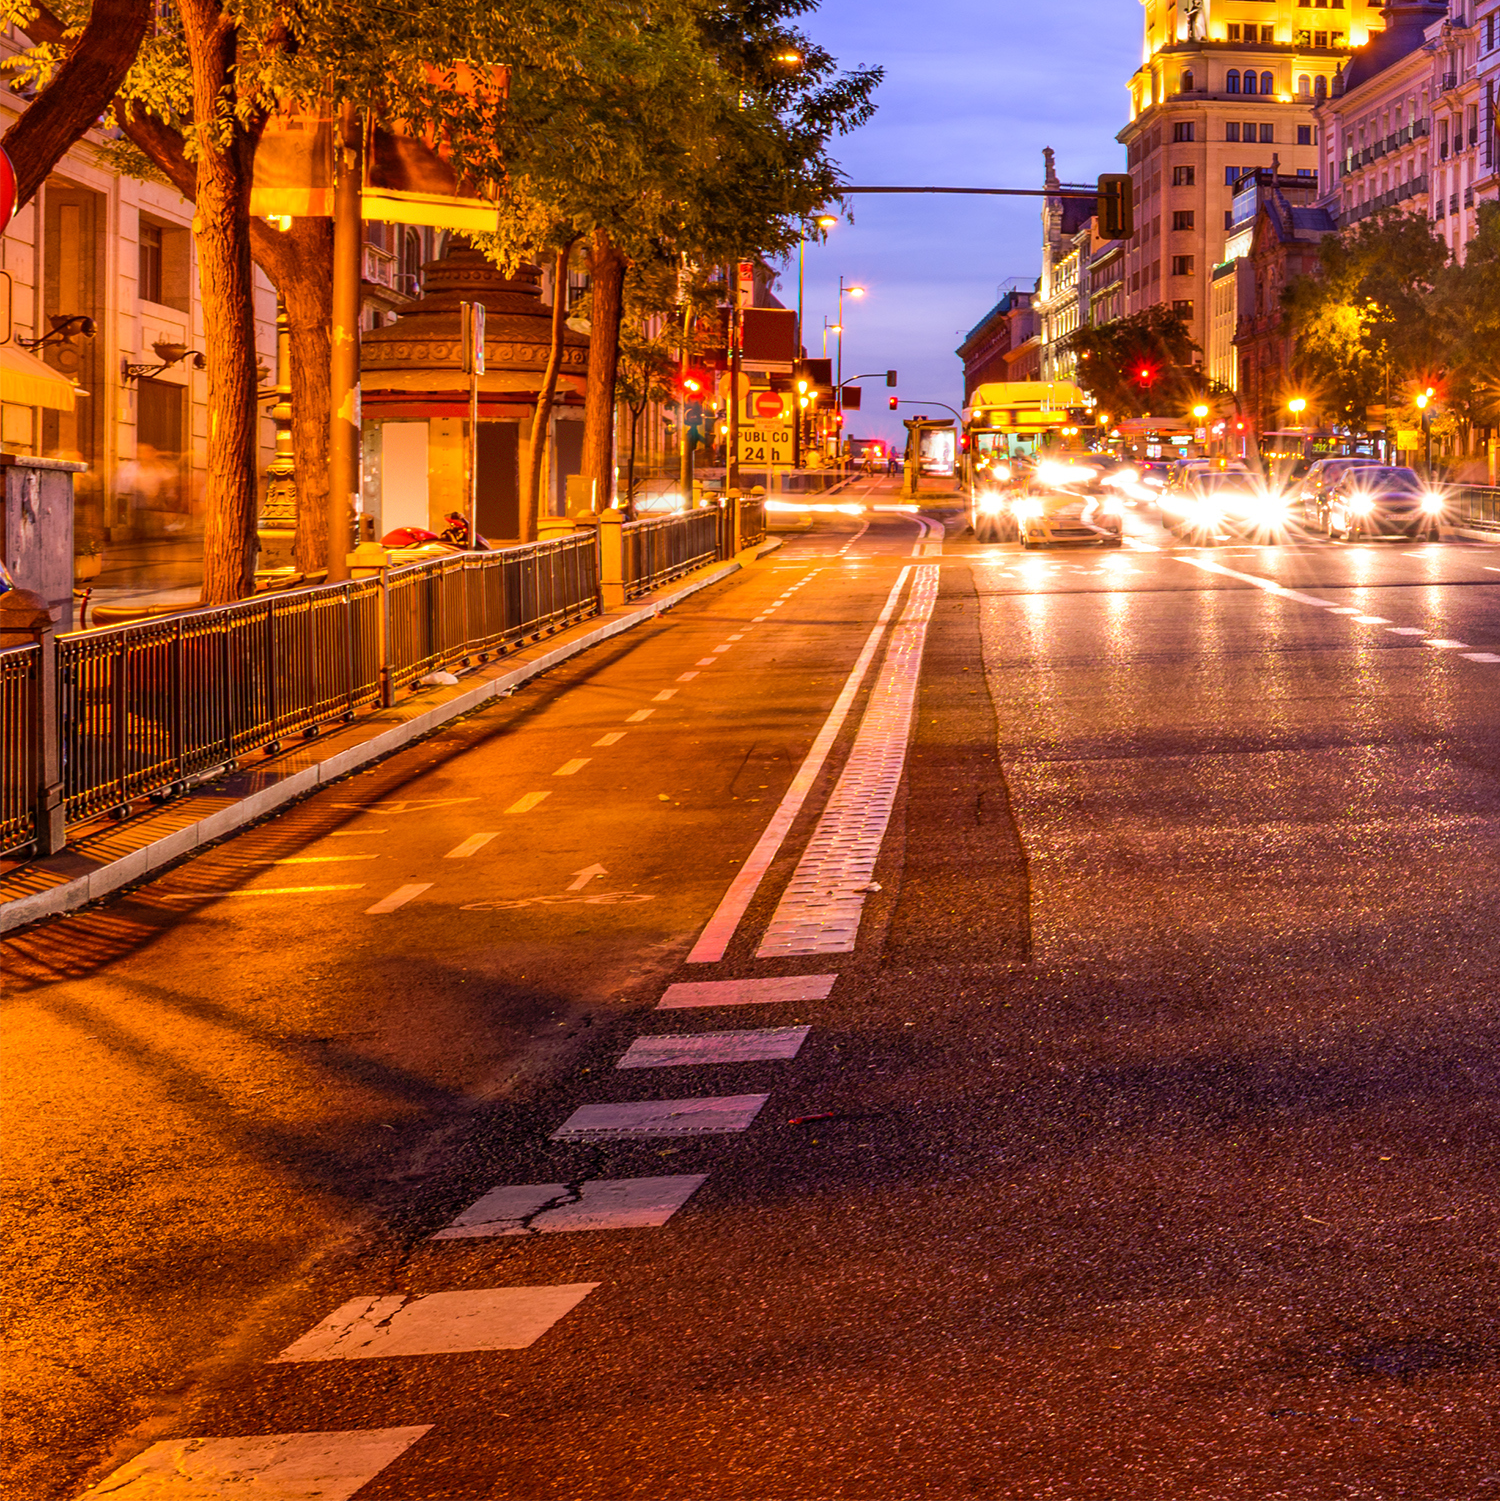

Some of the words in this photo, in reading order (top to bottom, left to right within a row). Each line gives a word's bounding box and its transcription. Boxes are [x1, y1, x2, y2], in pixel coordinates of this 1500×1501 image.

[737, 428, 789, 443] PÚBLCO
[744, 447, 765, 461] 24
[771, 447, 780, 461] h
